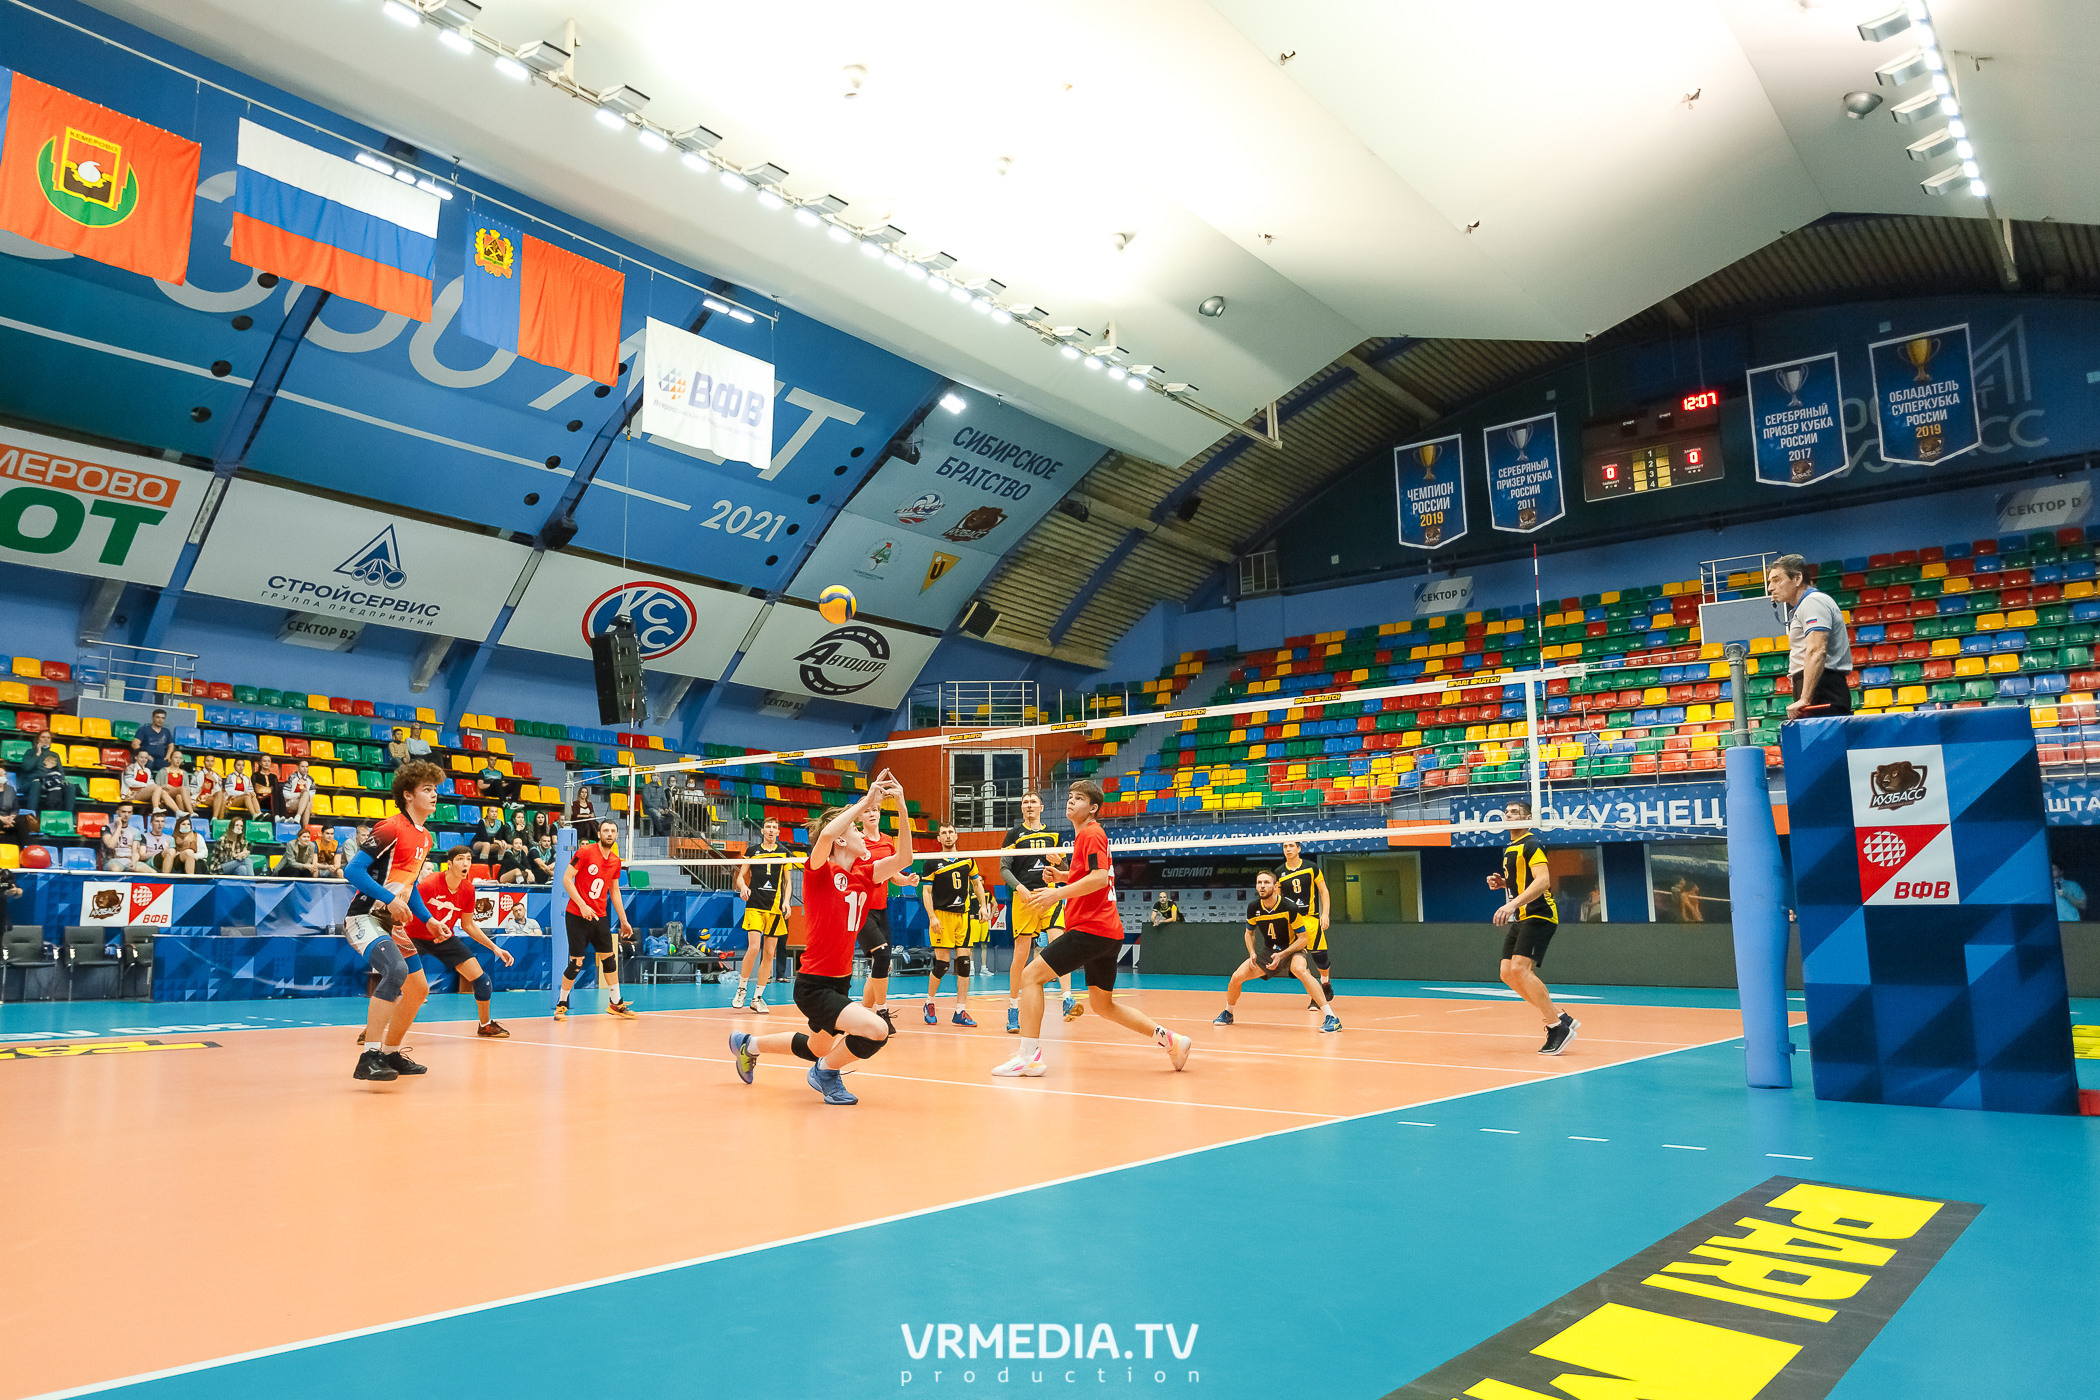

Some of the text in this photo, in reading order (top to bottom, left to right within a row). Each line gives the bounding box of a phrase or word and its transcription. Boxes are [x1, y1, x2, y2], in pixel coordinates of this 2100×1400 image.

[70, 131, 118, 152] КЕМЕРОВО
[688, 371, 765, 428] ВФВ
[1889, 380, 1959, 403] ОБЛАДАТЕЛЬ
[1683, 392, 1718, 411] 12:07
[1891, 393, 1960, 416] СУПЕРКУБКА
[1765, 403, 1829, 426] СЕРЕБРЯНЫЙ
[1906, 409, 1948, 427] РОССИИ
[1763, 417, 1834, 439] ПРИЗЕР КУБКА
[1916, 424, 1941, 438] 2019
[1780, 433, 1818, 449] РОССИИ
[952, 426, 1063, 480] СИБИРСКОЕ
[1647, 450, 1652, 458] 1
[1689, 452, 1698, 464] 0
[1789, 448, 1812, 462] 2017
[1498, 457, 1549, 479] СЕРЕБРЯНЫЙ
[1606, 467, 1615, 479] 0
[1648, 460, 1653, 468] 2
[935, 456, 1032, 501] БРАТСТВО
[1497, 470, 1553, 490] ПРИЗЕР КУБКА
[1650, 480, 1655, 488] 4
[1407, 482, 1454, 502] ЧЕМПИОН
[1510, 484, 1541, 499] РОССИИ
[1412, 497, 1450, 515] РОССИИ
[1517, 498, 1536, 510] 2011
[2007, 497, 2081, 517] СЕКТОР D
[700, 500, 786, 542] 2021
[1420, 511, 1444, 527] 2019
[268, 575, 441, 617] СТРОЙСЕРВИС
[1420, 588, 1468, 603] СЕКТОР D
[260, 591, 434, 626] ГРУППА ПРЕДПРИЯТИЙ
[287, 620, 356, 640] СЕКТОР В2
[1447, 678, 1469, 687] PARI
[763, 698, 793, 710] СЕКТОР
[1872, 788, 1923, 806] КУЗБАСС
[1458, 797, 1727, 835] НООКУЗНЕЦ
[415, 846, 424, 861] 12
[952, 872, 962, 889] 6
[1162, 867, 1213, 878] СУПЕРЛИГА
[588, 878, 604, 900] 9
[1292, 879, 1302, 893] 8
[1894, 881, 1950, 900] ВФВ
[143, 914, 168, 924] ВФВ
[1267, 922, 1277, 940] 4
[1640, 1183, 1945, 1323] PARI
